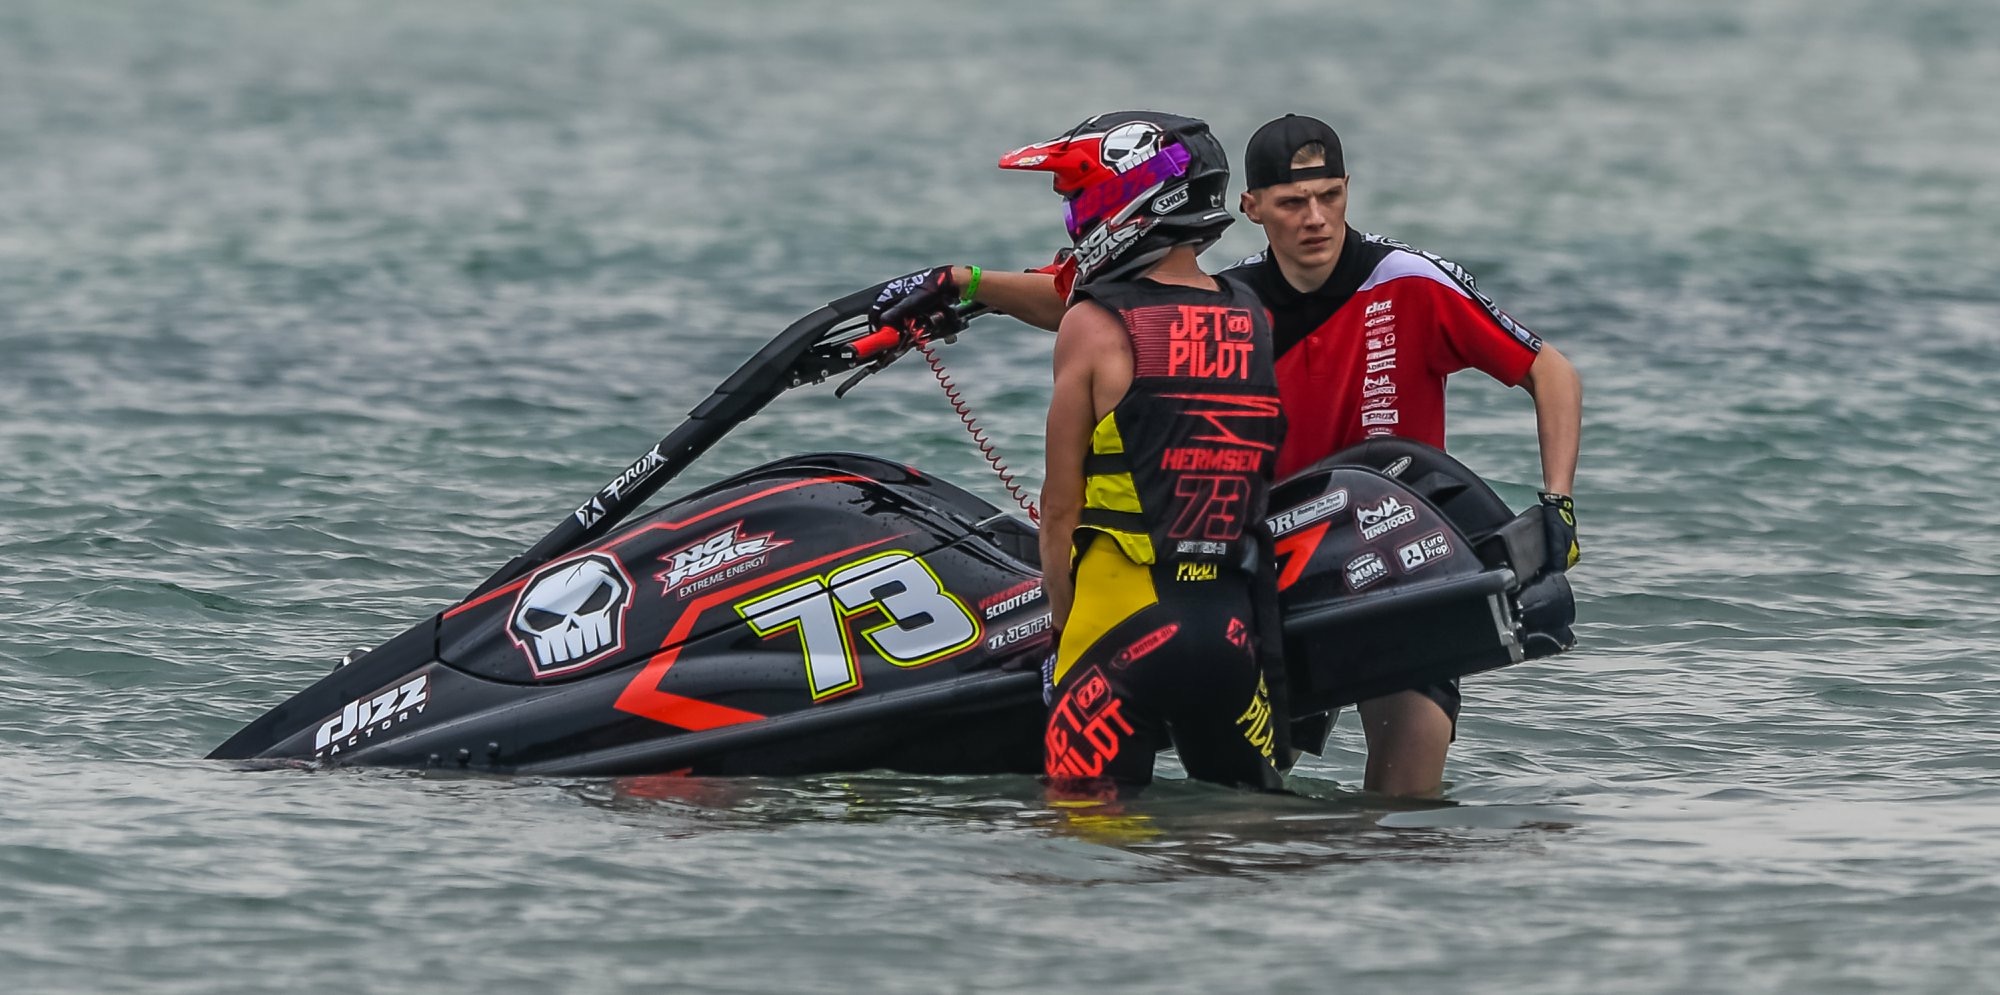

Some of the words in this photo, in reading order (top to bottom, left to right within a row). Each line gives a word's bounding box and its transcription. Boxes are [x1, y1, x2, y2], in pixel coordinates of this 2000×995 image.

[1073, 223, 1108, 260] NO
[1169, 305, 1227, 341] JET
[1168, 340, 1254, 379] PILOT
[1161, 448, 1262, 472] HERMSEN
[1167, 474, 1251, 540] 73
[673, 530, 735, 570] NO
[1420, 535, 1445, 550] Euro
[1425, 544, 1448, 559] Prop
[680, 573, 725, 597] EXTREME
[726, 555, 766, 578] ENERGY
[986, 586, 1042, 620] SCOOTERS
[733, 550, 979, 700] 73
